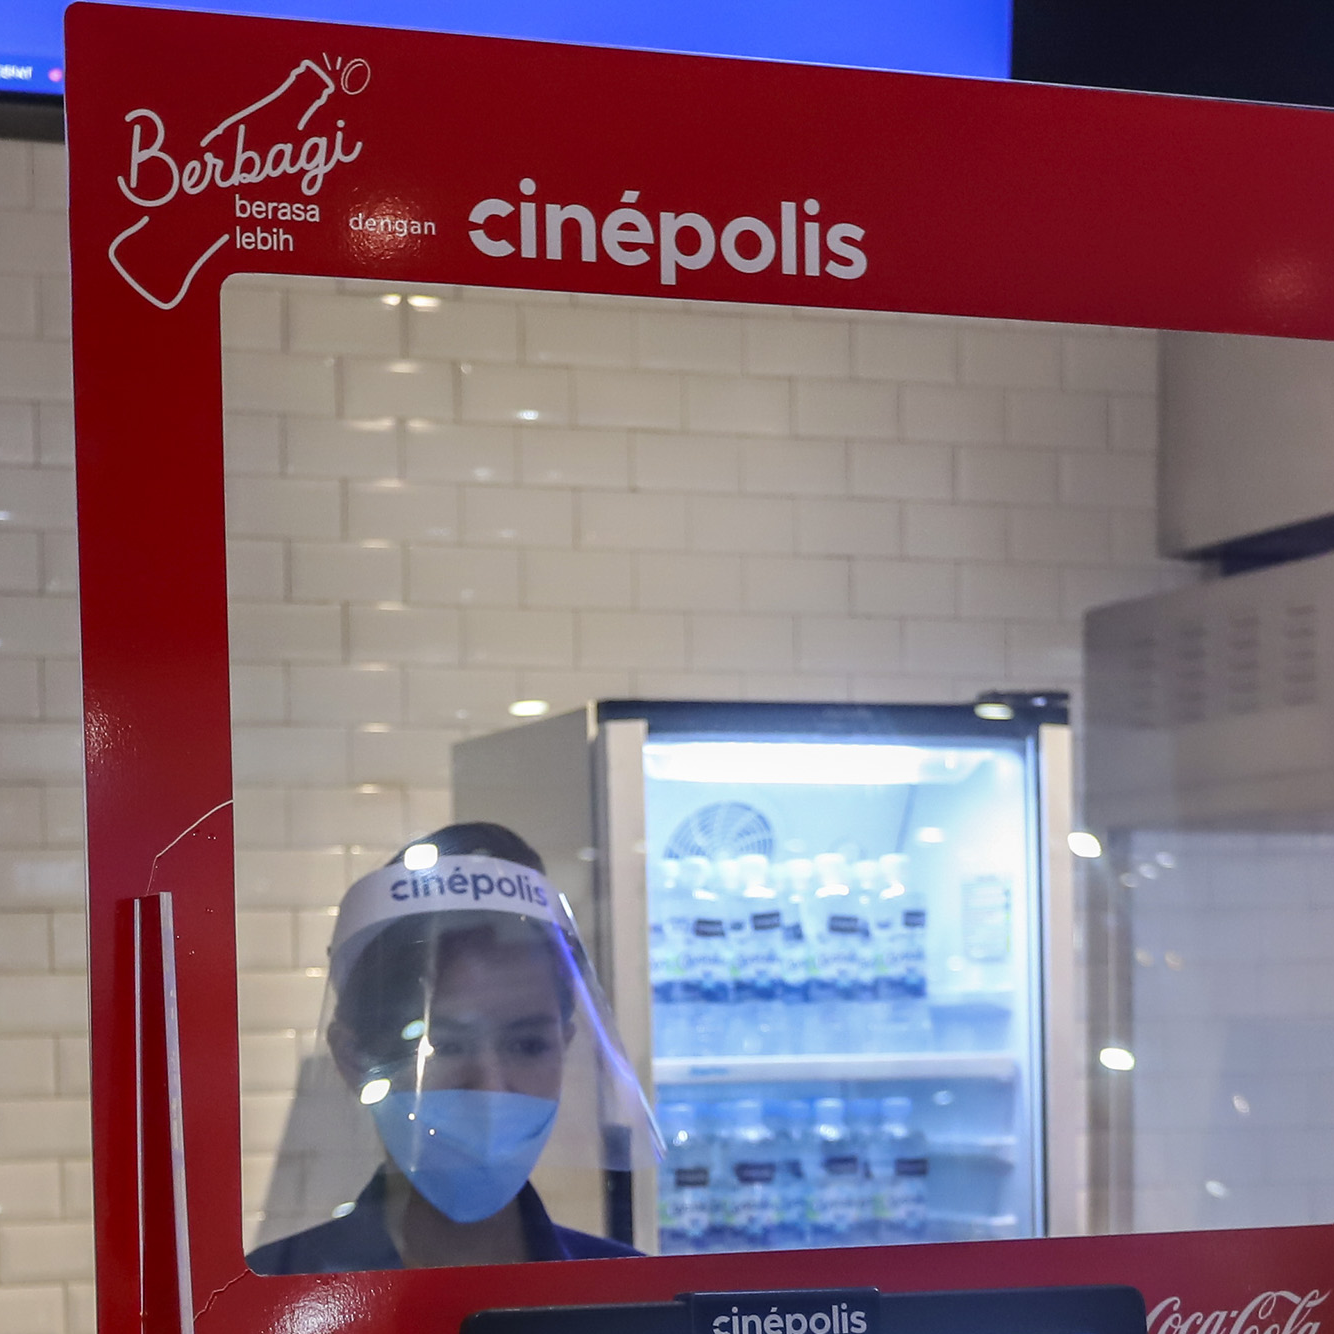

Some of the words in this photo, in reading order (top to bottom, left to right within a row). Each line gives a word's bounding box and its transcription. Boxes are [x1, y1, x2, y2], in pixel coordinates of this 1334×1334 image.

[117, 108, 363, 208] Berbagi
[235, 194, 321, 222] berasa
[349, 213, 436, 237] dengan
[236, 226, 294, 251] lebih
[468, 177, 867, 286] cinépolis
[390, 866, 548, 906] cinépolis
